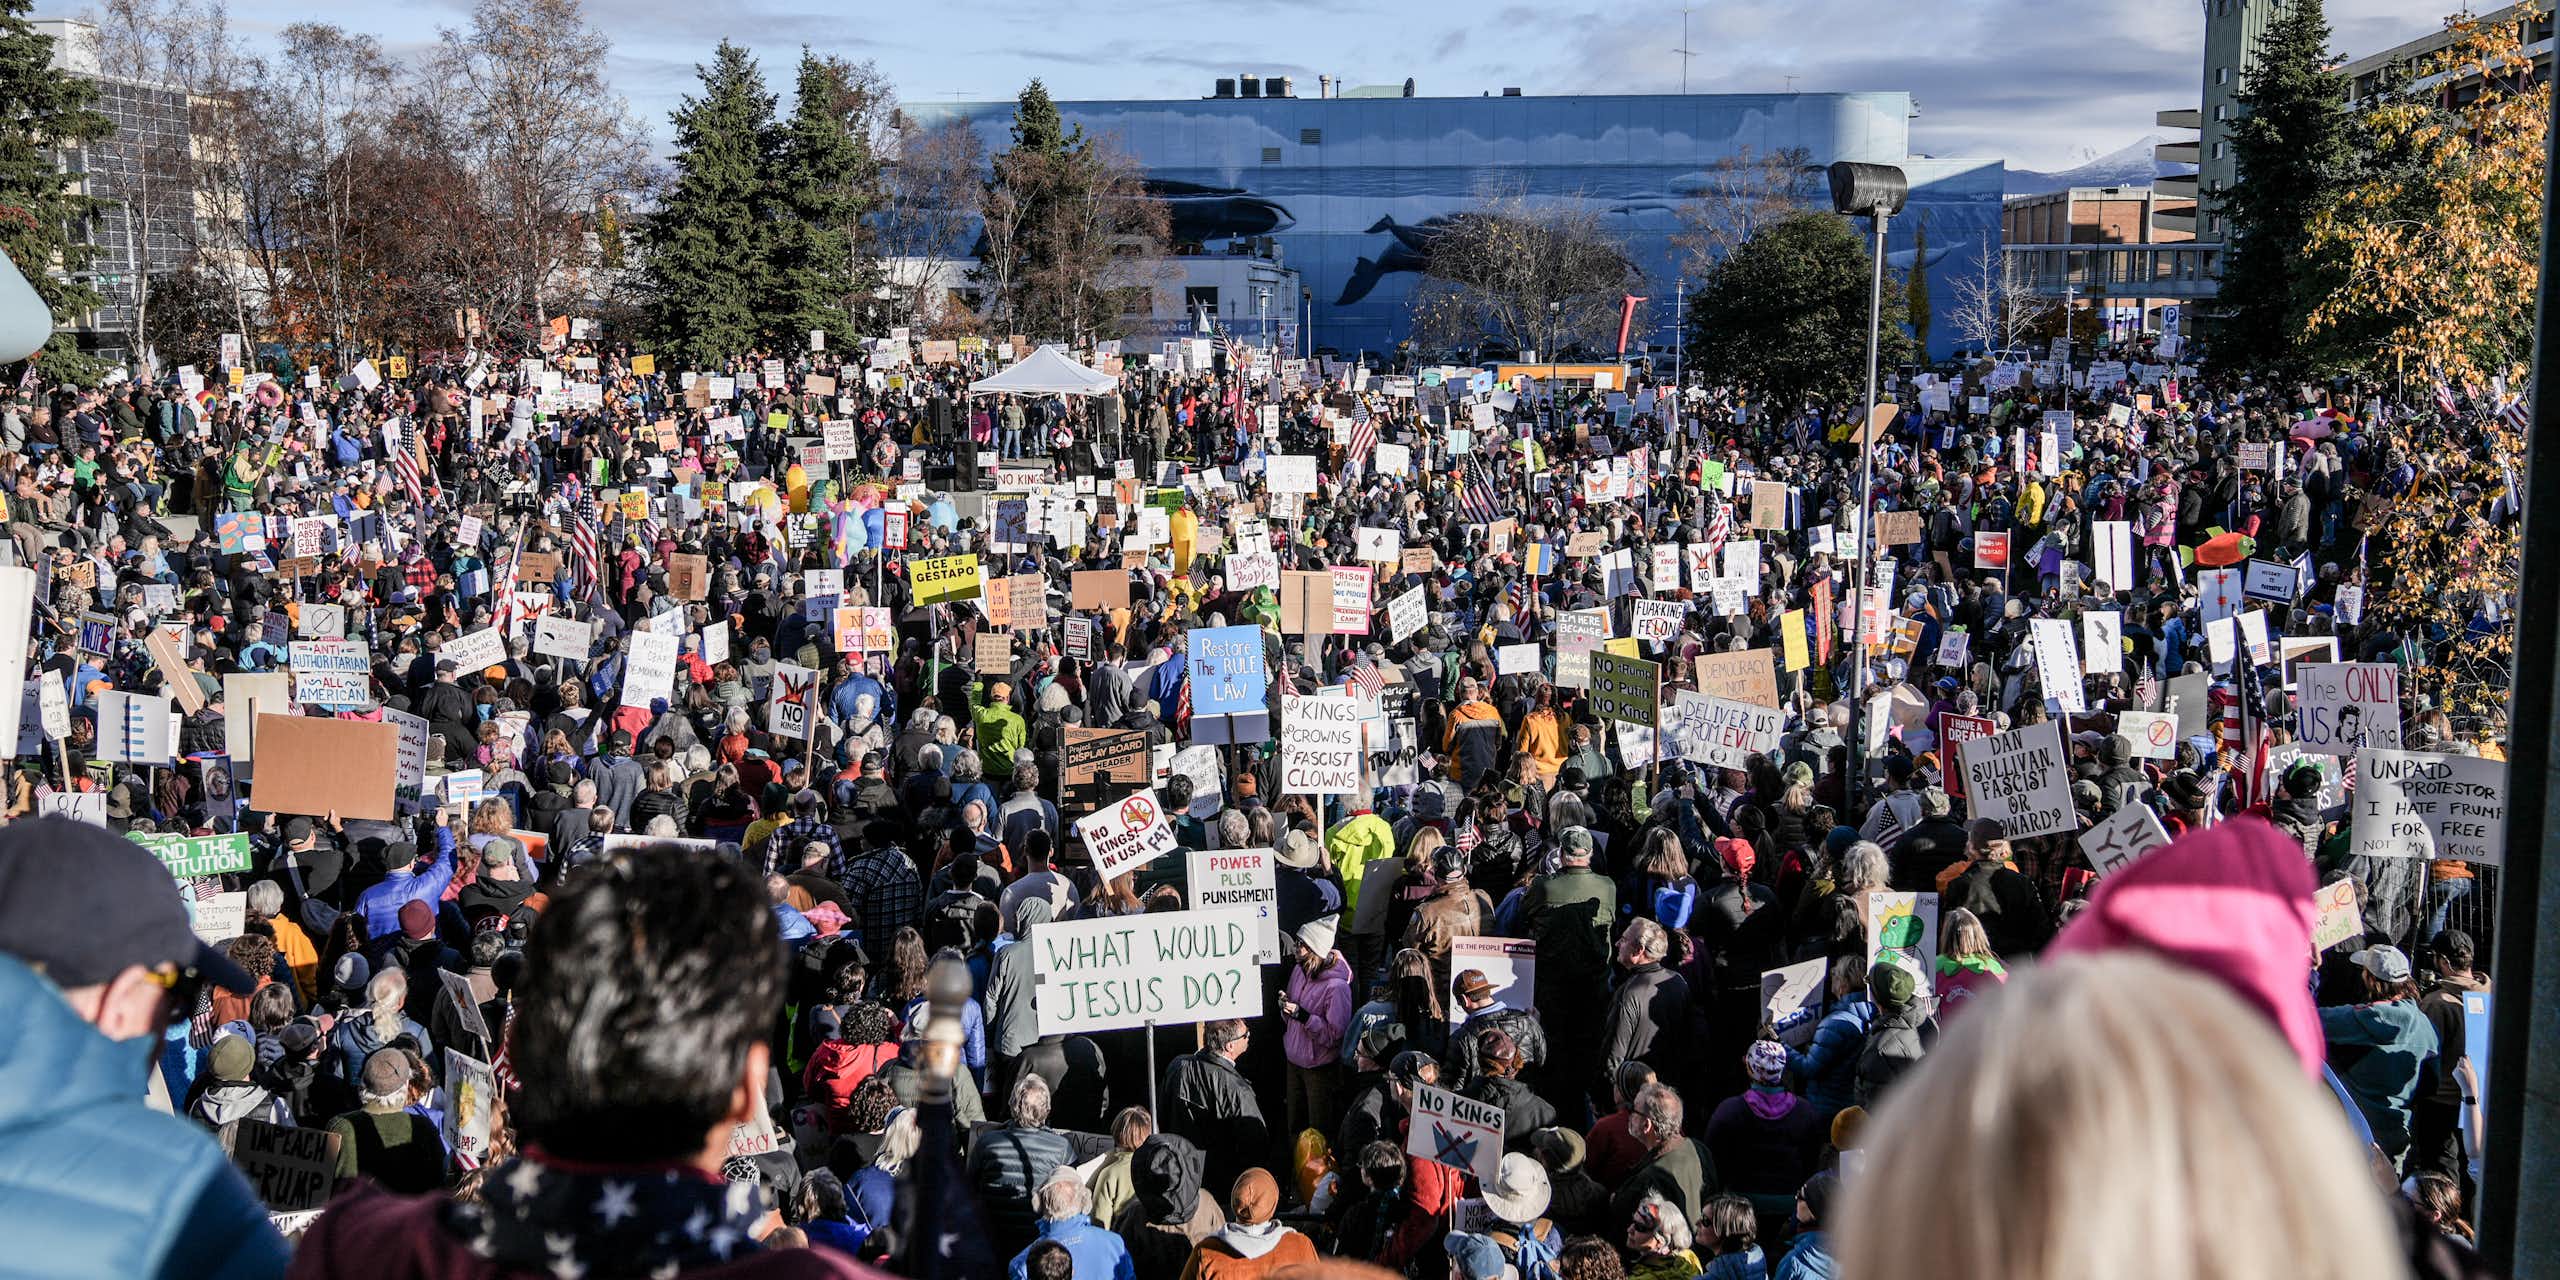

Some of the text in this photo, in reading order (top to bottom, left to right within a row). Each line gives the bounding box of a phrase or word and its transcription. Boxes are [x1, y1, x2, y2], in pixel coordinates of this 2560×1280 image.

[999, 473, 1045, 486] NO KINGS
[298, 520, 325, 529] MORON
[298, 529, 329, 538] ABSENT
[298, 538, 331, 547] GOLFING
[926, 559, 948, 570] ICE
[917, 567, 974, 582] GESTAPO
[1334, 572, 1364, 581] PRISON
[1698, 571, 1710, 581] NO
[851, 615, 874, 627] NO
[1578, 615, 1600, 626] HERE
[1639, 620, 1677, 636] FELON
[1560, 624, 1601, 636] BECAUSE
[313, 641, 340, 655] ANTI
[450, 641, 464, 651] NO
[844, 634, 887, 647] KING
[1202, 638, 1251, 657] Restore
[455, 650, 469, 660] NO
[292, 656, 368, 671] AUTHORITARIAN
[456, 658, 472, 670] NO
[1195, 655, 1258, 677] The RULE
[1594, 657, 1614, 673] NO
[1705, 659, 1767, 680] DEMOCRACY
[323, 678, 344, 688] ALL
[1224, 674, 1232, 683] of
[1594, 676, 1613, 692] NO
[2298, 667, 2396, 703] The ONLY
[299, 688, 366, 702] AMERICAN
[1213, 682, 1248, 701] LAW
[1726, 680, 1747, 696] NOT
[781, 704, 803, 724] NO
[1283, 698, 1356, 721] NO KINGS
[1594, 696, 1653, 724] NO King!
[1685, 700, 1774, 734] DELIVER US
[780, 720, 803, 733] KINGS
[1951, 718, 1983, 732] I HAVE A
[2299, 706, 2330, 745] US
[1282, 723, 1351, 744] NO CROWNS
[1684, 718, 1758, 752] FROM EVIL
[1068, 744, 1090, 754] Project
[1989, 731, 2023, 755] DAN
[1068, 741, 1143, 764] DISPLAY BOARD
[1282, 744, 1353, 766] NO FASCIST
[1368, 745, 1416, 771] TRUMP
[1095, 756, 1132, 769] HEADER
[1972, 747, 2056, 783] SULLIVAN,
[2371, 759, 2453, 779] UNPAID
[1288, 769, 1355, 788] CLOWNS
[1981, 768, 2048, 800] FASCIST
[2402, 781, 2496, 800] PROTESTOR
[2007, 793, 2031, 814] OR
[2368, 800, 2437, 816] I HATE
[2000, 808, 2062, 837] OWARD?
[2392, 822, 2485, 837] FOR FREE
[1090, 825, 1108, 842] NO
[1097, 826, 1140, 855] KINGS!
[199, 836, 237, 852] THE
[2096, 827, 2130, 874] YE
[2363, 839, 2390, 851] NOT
[2407, 842, 2424, 854] MY
[1103, 842, 1146, 869] IN USA
[1210, 855, 1262, 871] POWER
[1221, 873, 1253, 886] PLUS
[1202, 888, 1274, 904] PUNISHMENT
[1871, 895, 1883, 903] NO
[1047, 922, 1245, 973] WHAT WOULD
[1057, 969, 1241, 1022] JESUS DO?
[1776, 1003, 1823, 1034] ESIST
[1419, 1088, 1502, 1129] NO KINGS
[250, 1126, 328, 1160] IMPEACH
